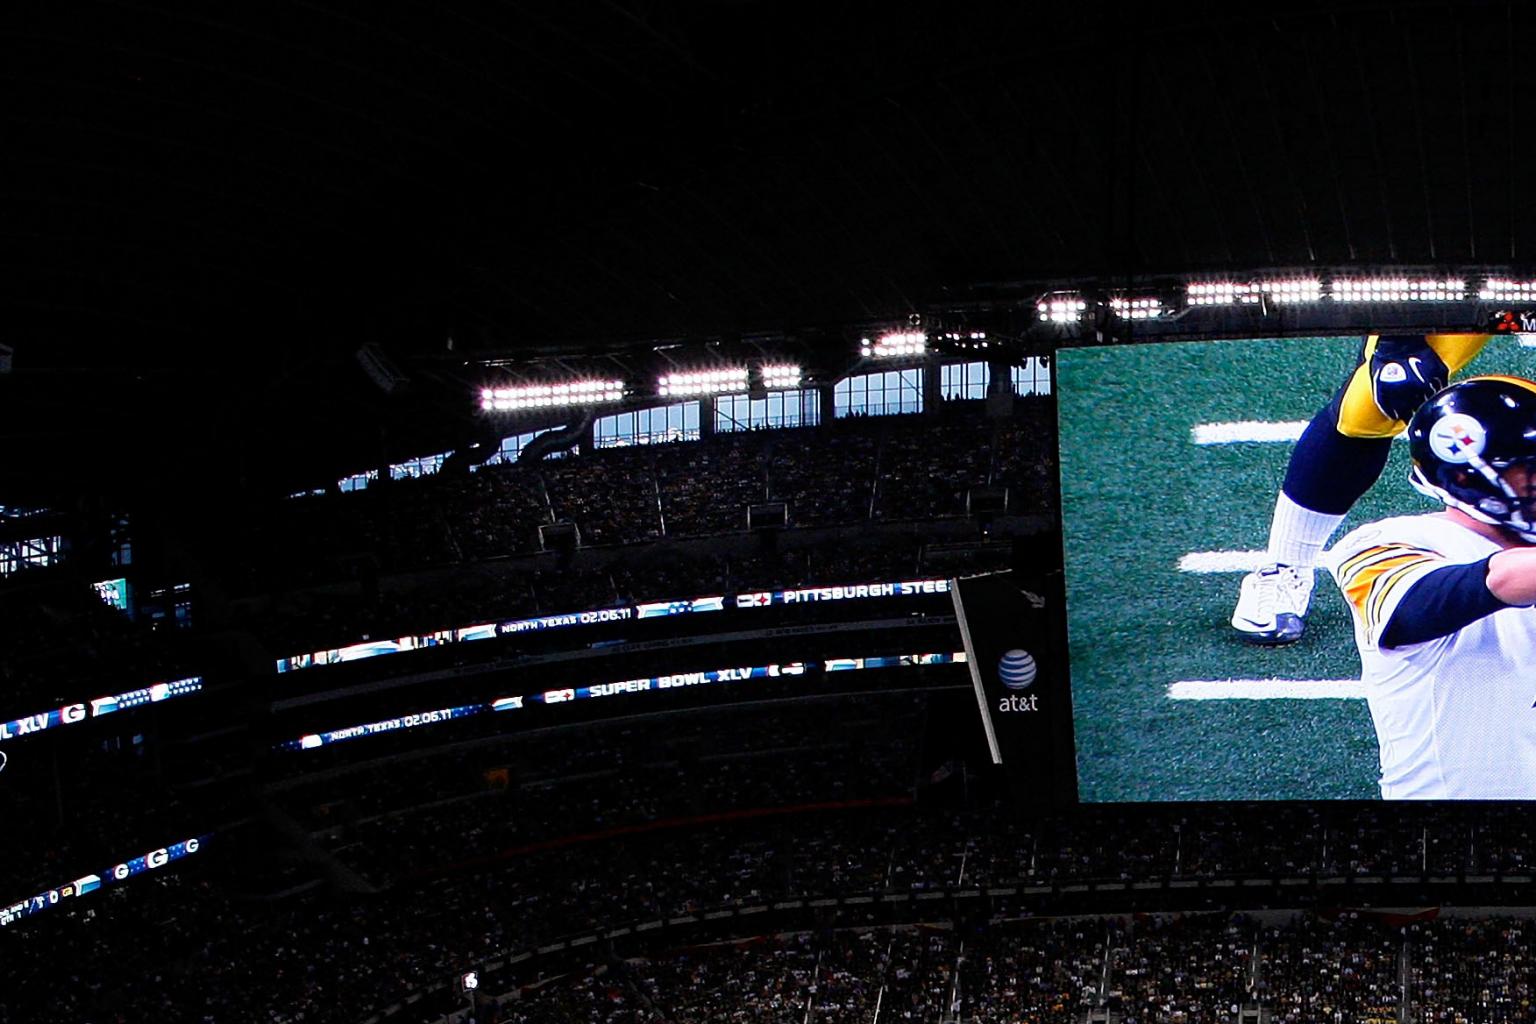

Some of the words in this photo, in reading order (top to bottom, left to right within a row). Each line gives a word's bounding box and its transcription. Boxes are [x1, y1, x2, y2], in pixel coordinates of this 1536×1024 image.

[783, 583, 895, 604] PITTSBURGH
[501, 620, 538, 634] NORTH
[541, 616, 577, 629] TEXAS
[580, 608, 632, 625] 02.06.11
[589, 678, 651, 698] SUPER
[658, 671, 711, 689] BOWL
[717, 666, 753, 683] XLV
[999, 693, 1039, 712] at&t
[18, 712, 49, 736] XLV
[331, 727, 366, 742] NORTH
[368, 718, 401, 734] TEXAS
[404, 708, 453, 728] 02.06.11
